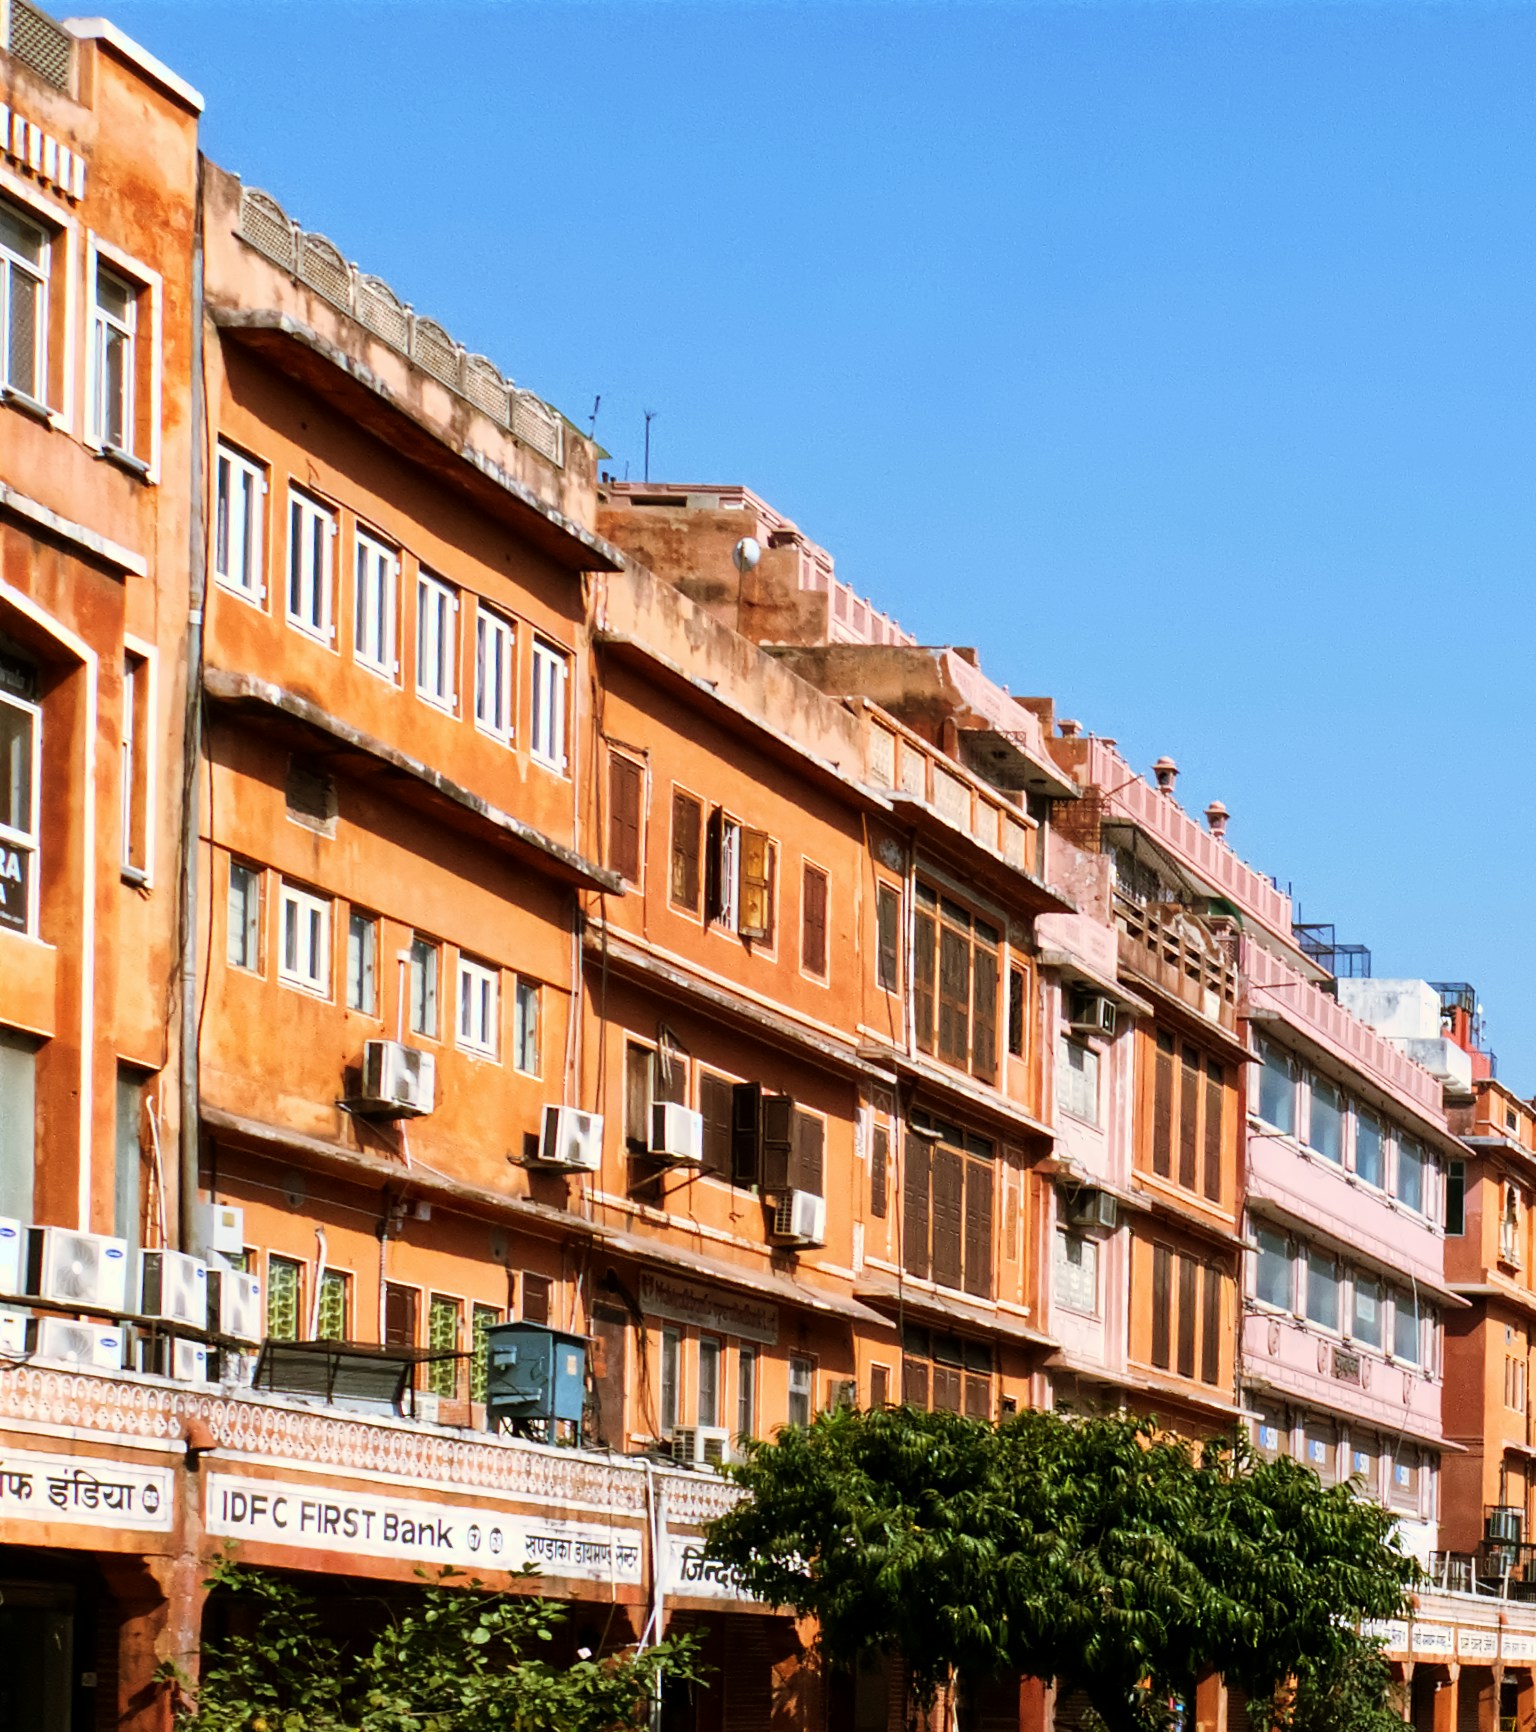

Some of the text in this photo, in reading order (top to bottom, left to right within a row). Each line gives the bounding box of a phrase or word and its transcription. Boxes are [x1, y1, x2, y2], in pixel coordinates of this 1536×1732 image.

[0, 1461, 33, 1500] फ
[46, 1468, 136, 1511] इंडिया
[222, 1490, 288, 1528] IDFC
[300, 1500, 376, 1539] FIRST
[383, 1506, 454, 1549] Bank
